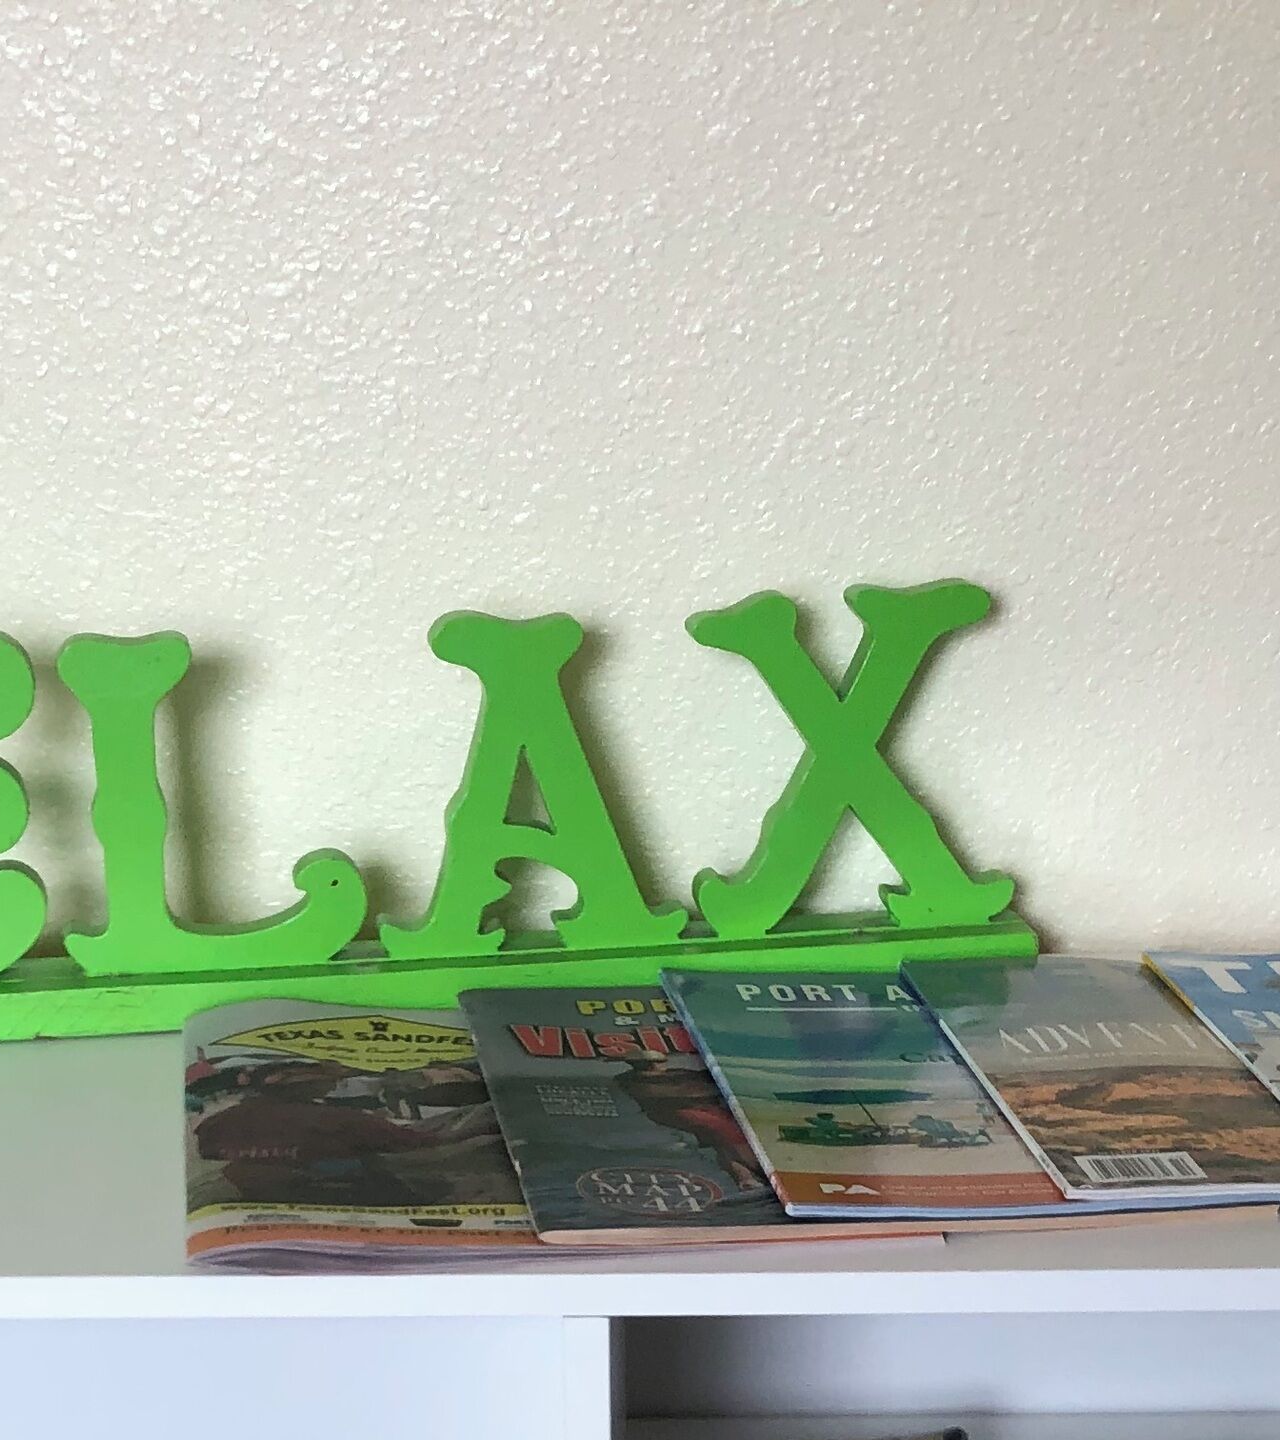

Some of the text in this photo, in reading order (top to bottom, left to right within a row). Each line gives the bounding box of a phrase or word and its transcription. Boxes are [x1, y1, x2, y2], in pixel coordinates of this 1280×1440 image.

[735, 984, 856, 1002] PORT
[256, 1029, 344, 1043] TEXAS
[819, 1182, 882, 1196] PA
